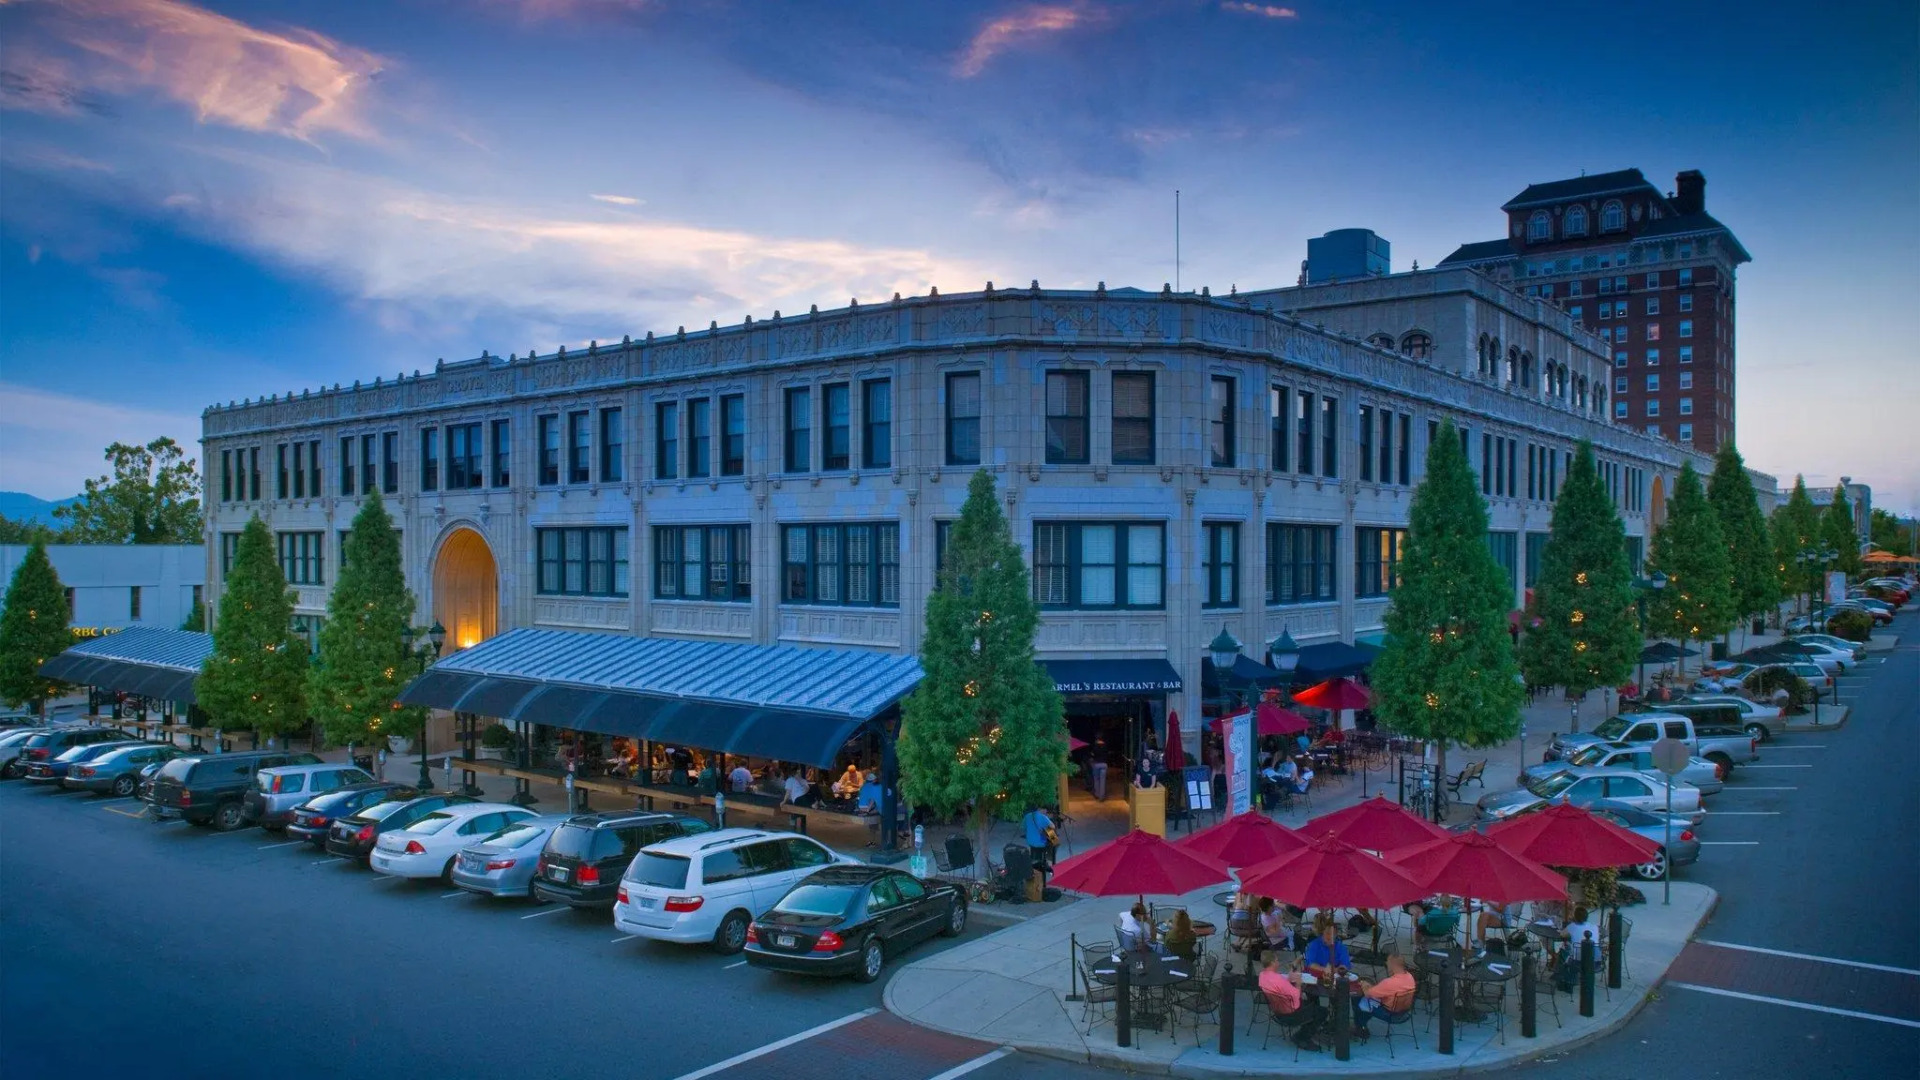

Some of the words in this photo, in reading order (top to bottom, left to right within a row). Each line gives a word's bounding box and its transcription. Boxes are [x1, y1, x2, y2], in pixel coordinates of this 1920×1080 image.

[72, 627, 99, 637] RBC
[1051, 682, 1090, 692] ARMEL'S
[1093, 681, 1155, 690] RESTAURANT
[1163, 681, 1181, 689] BAR
